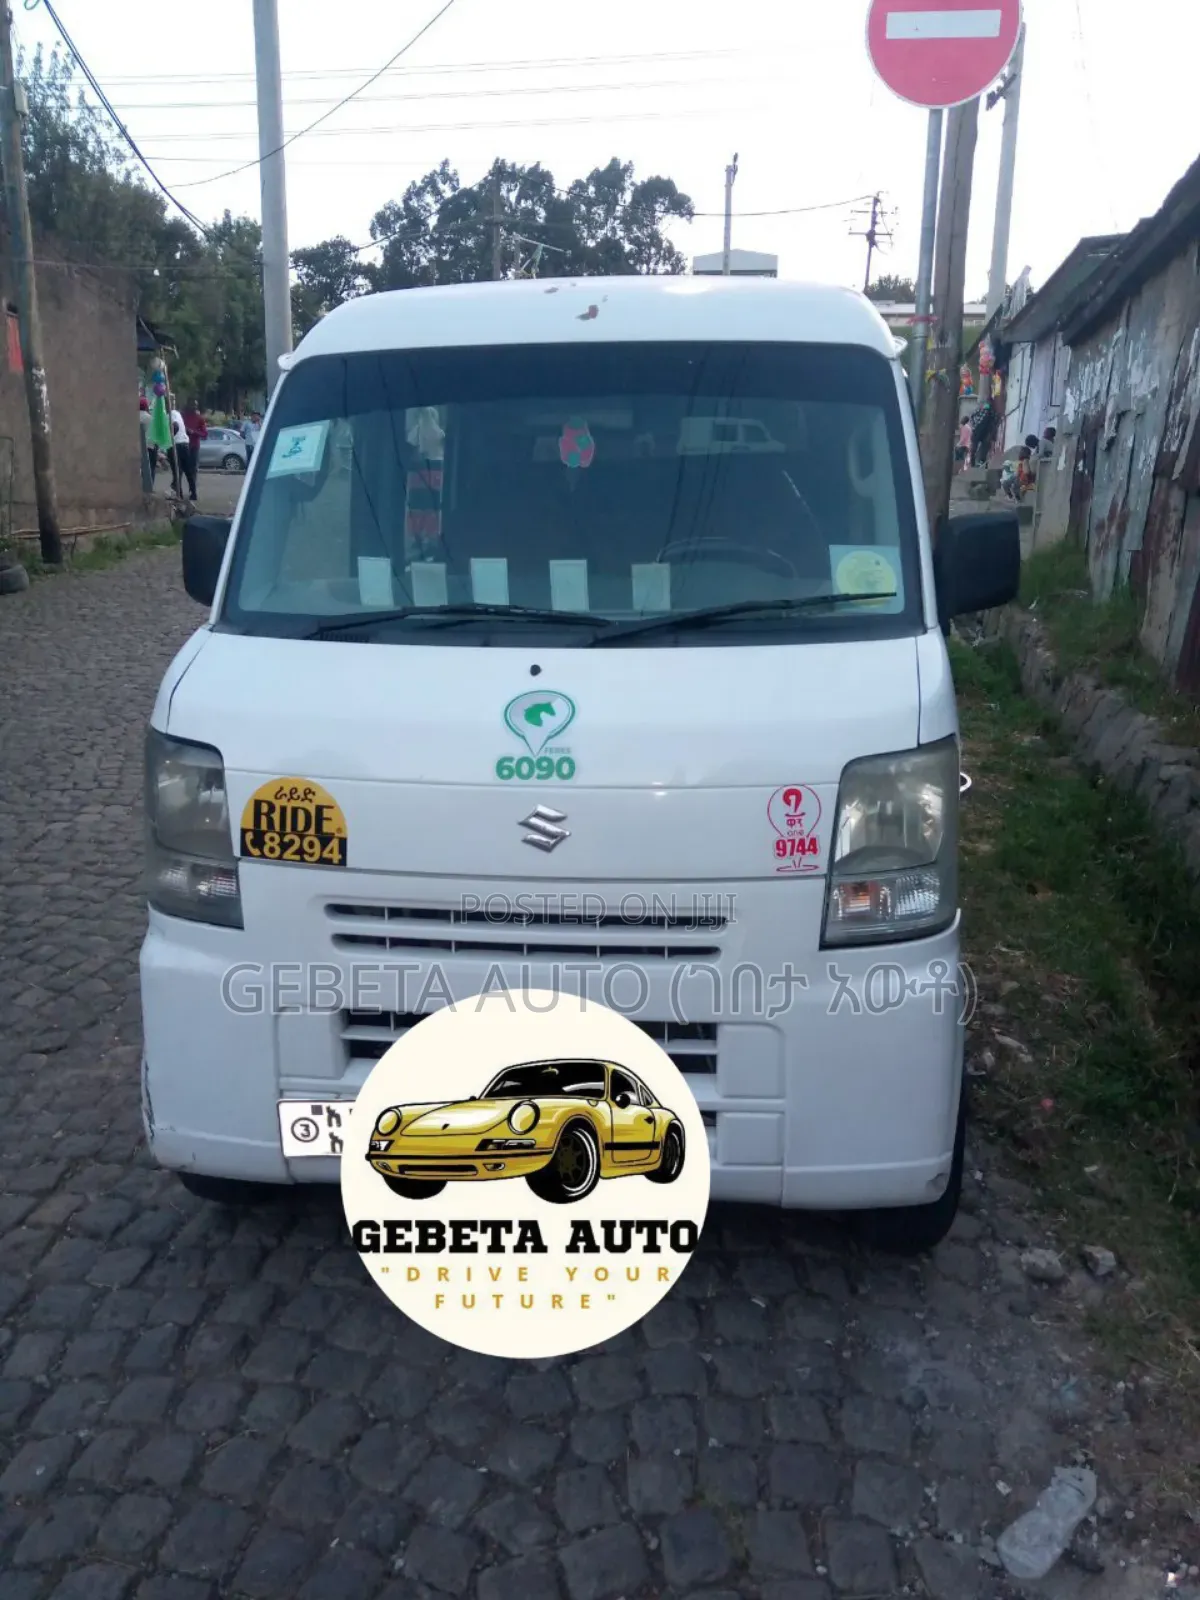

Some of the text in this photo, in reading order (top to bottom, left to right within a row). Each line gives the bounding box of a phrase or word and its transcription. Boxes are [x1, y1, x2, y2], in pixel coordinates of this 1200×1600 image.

[495, 756, 576, 780] 6090
[274, 786, 316, 803] ራይድ
[253, 799, 335, 836] RIDE
[263, 832, 342, 864] 8294
[775, 837, 818, 857] 9744
